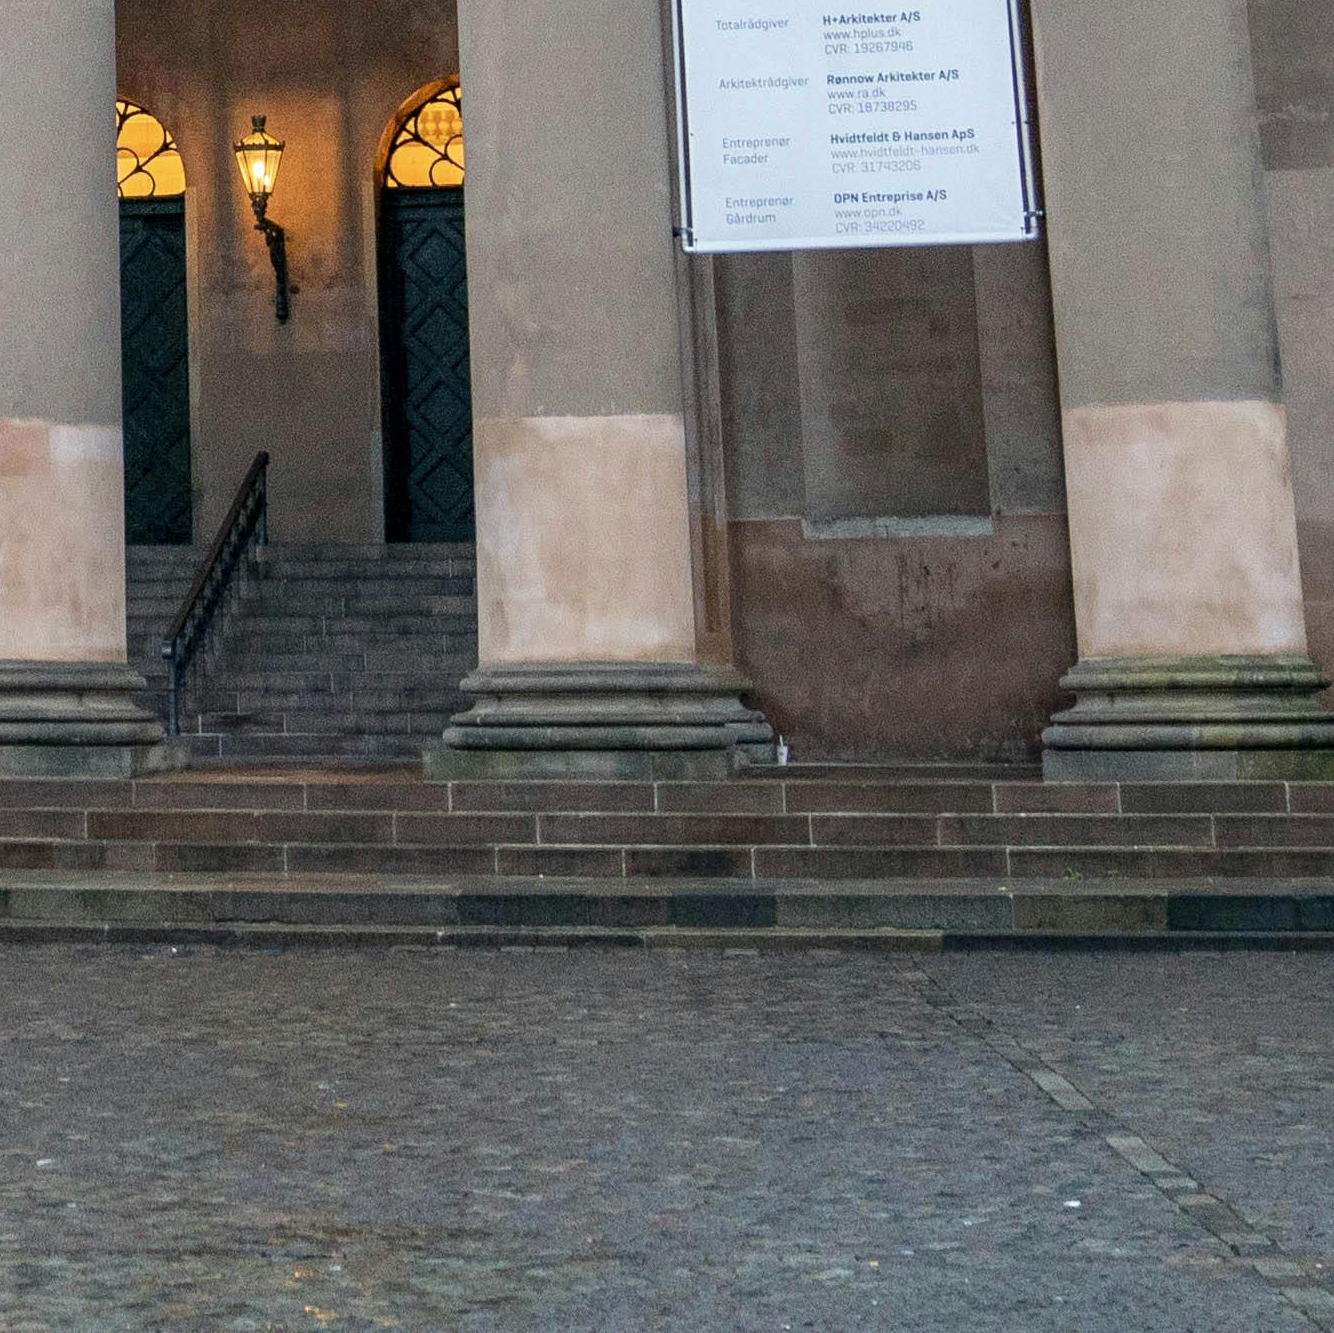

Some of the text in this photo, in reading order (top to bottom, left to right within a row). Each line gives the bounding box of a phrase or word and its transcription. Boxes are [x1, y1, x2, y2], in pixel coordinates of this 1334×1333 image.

[715, 18, 789, 31] Totalrådgiver
[823, 11, 921, 25] H+Arkitekter A/S
[824, 27, 901, 41] www.hplus.dk
[825, 44, 850, 55] CVR:
[719, 77, 809, 89] Arkitektrådgiver
[827, 69, 959, 85] Rønnow Arkitekter A/S
[828, 87, 885, 99] www.ra.dk
[829, 103, 854, 115] CVR:
[831, 128, 975, 144] Hvidtfeldt & Hansen ApS
[723, 137, 790, 149] Entreprenør
[723, 153, 768, 164] Facader
[726, 196, 794, 209] Entreprenør
[834, 190, 947, 204] OPN Entreprise A/S
[726, 212, 776, 225] Gårdrum
